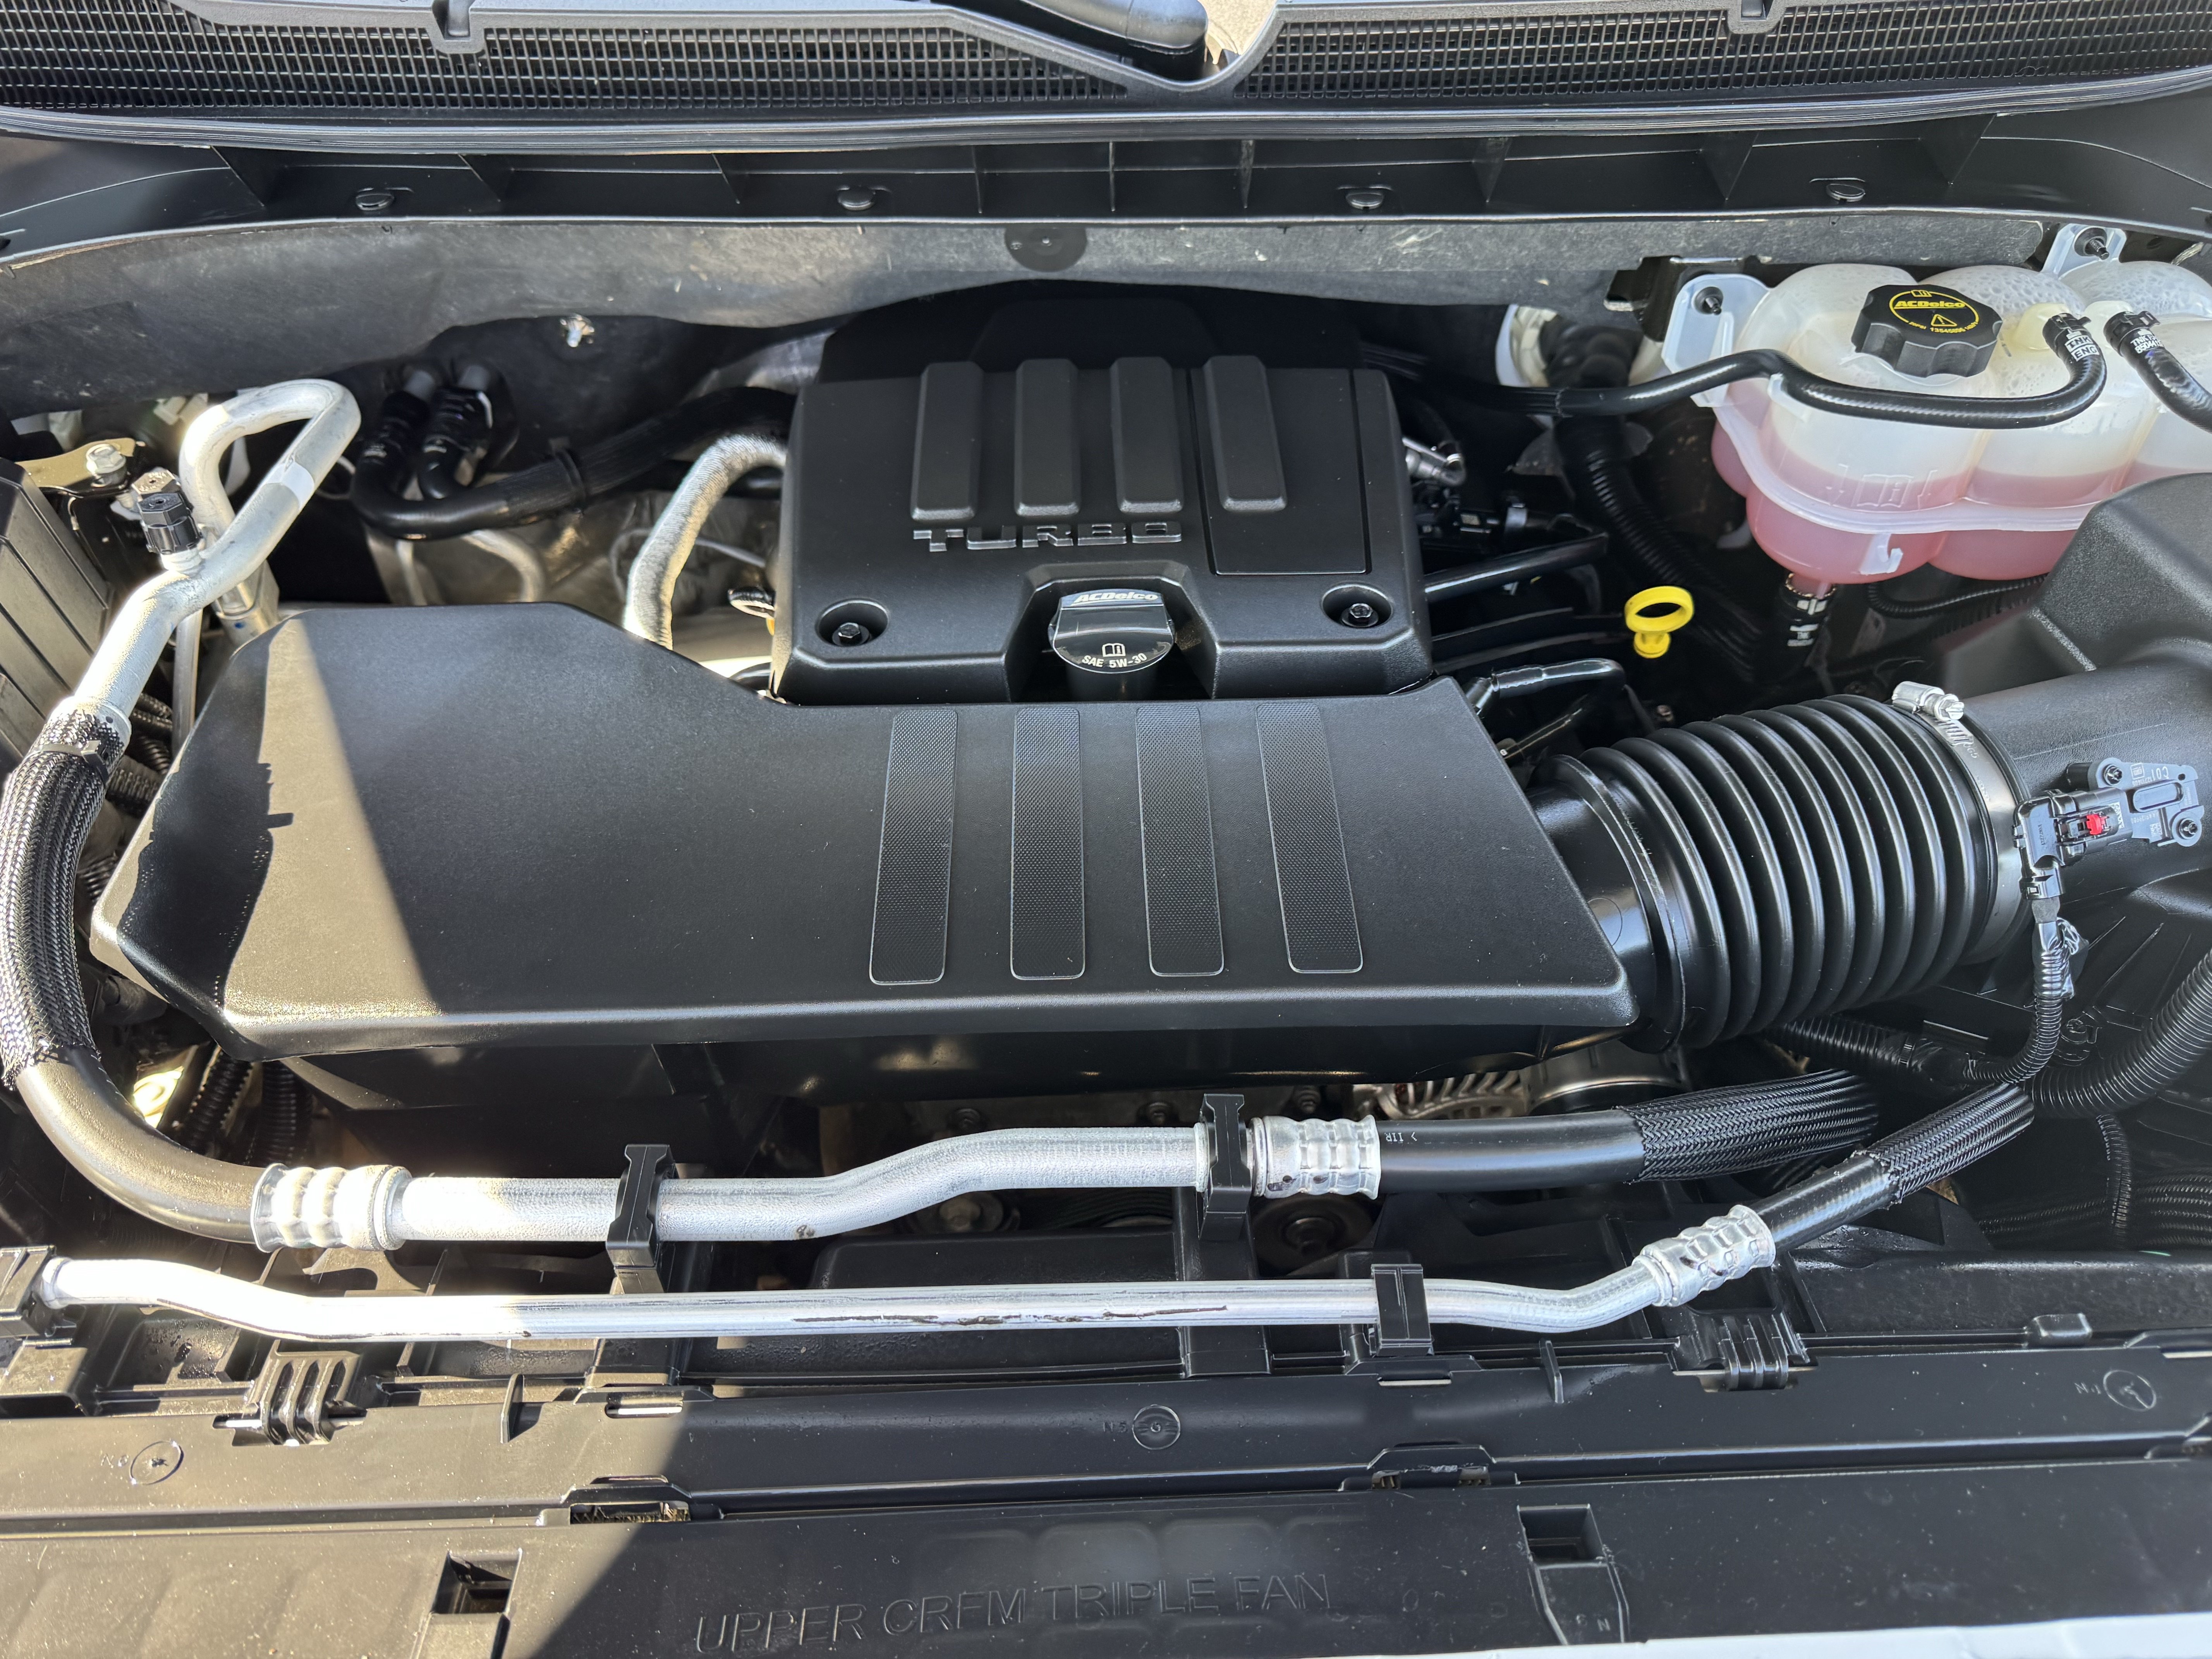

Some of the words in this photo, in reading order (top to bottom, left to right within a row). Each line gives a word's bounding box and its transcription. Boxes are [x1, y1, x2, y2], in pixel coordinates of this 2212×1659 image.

[2075, 346, 2098, 359] ENG
[913, 522, 1182, 552] TURBO
[1073, 592, 1158, 604] ACDelco
[1082, 655, 1104, 667] SAE
[1109, 653, 1147, 668] 5W-30
[697, 1603, 867, 1653] UPPER
[1041, 1577, 1219, 1620] TRIPLE
[1234, 1573, 1330, 1611] FAN
